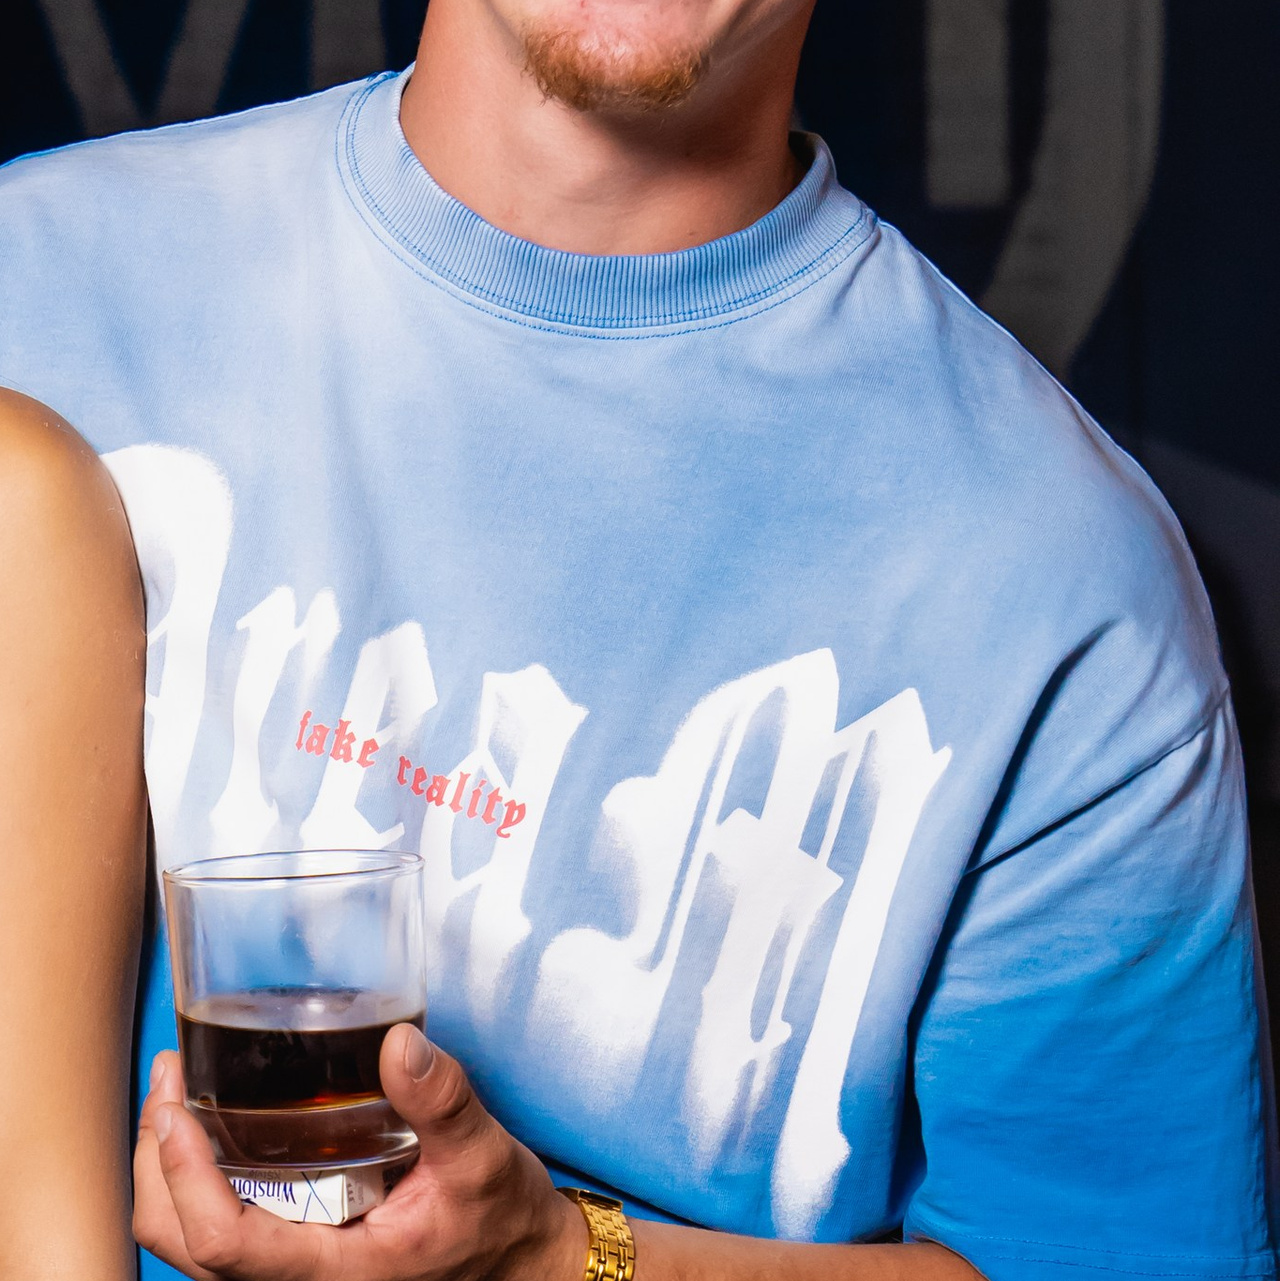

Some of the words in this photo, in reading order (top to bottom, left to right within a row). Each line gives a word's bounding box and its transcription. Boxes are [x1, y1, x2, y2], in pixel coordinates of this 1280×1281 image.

[295, 709, 380, 769] fake
[396, 754, 527, 839] reality
[232, 1177, 297, 1205] Winston
